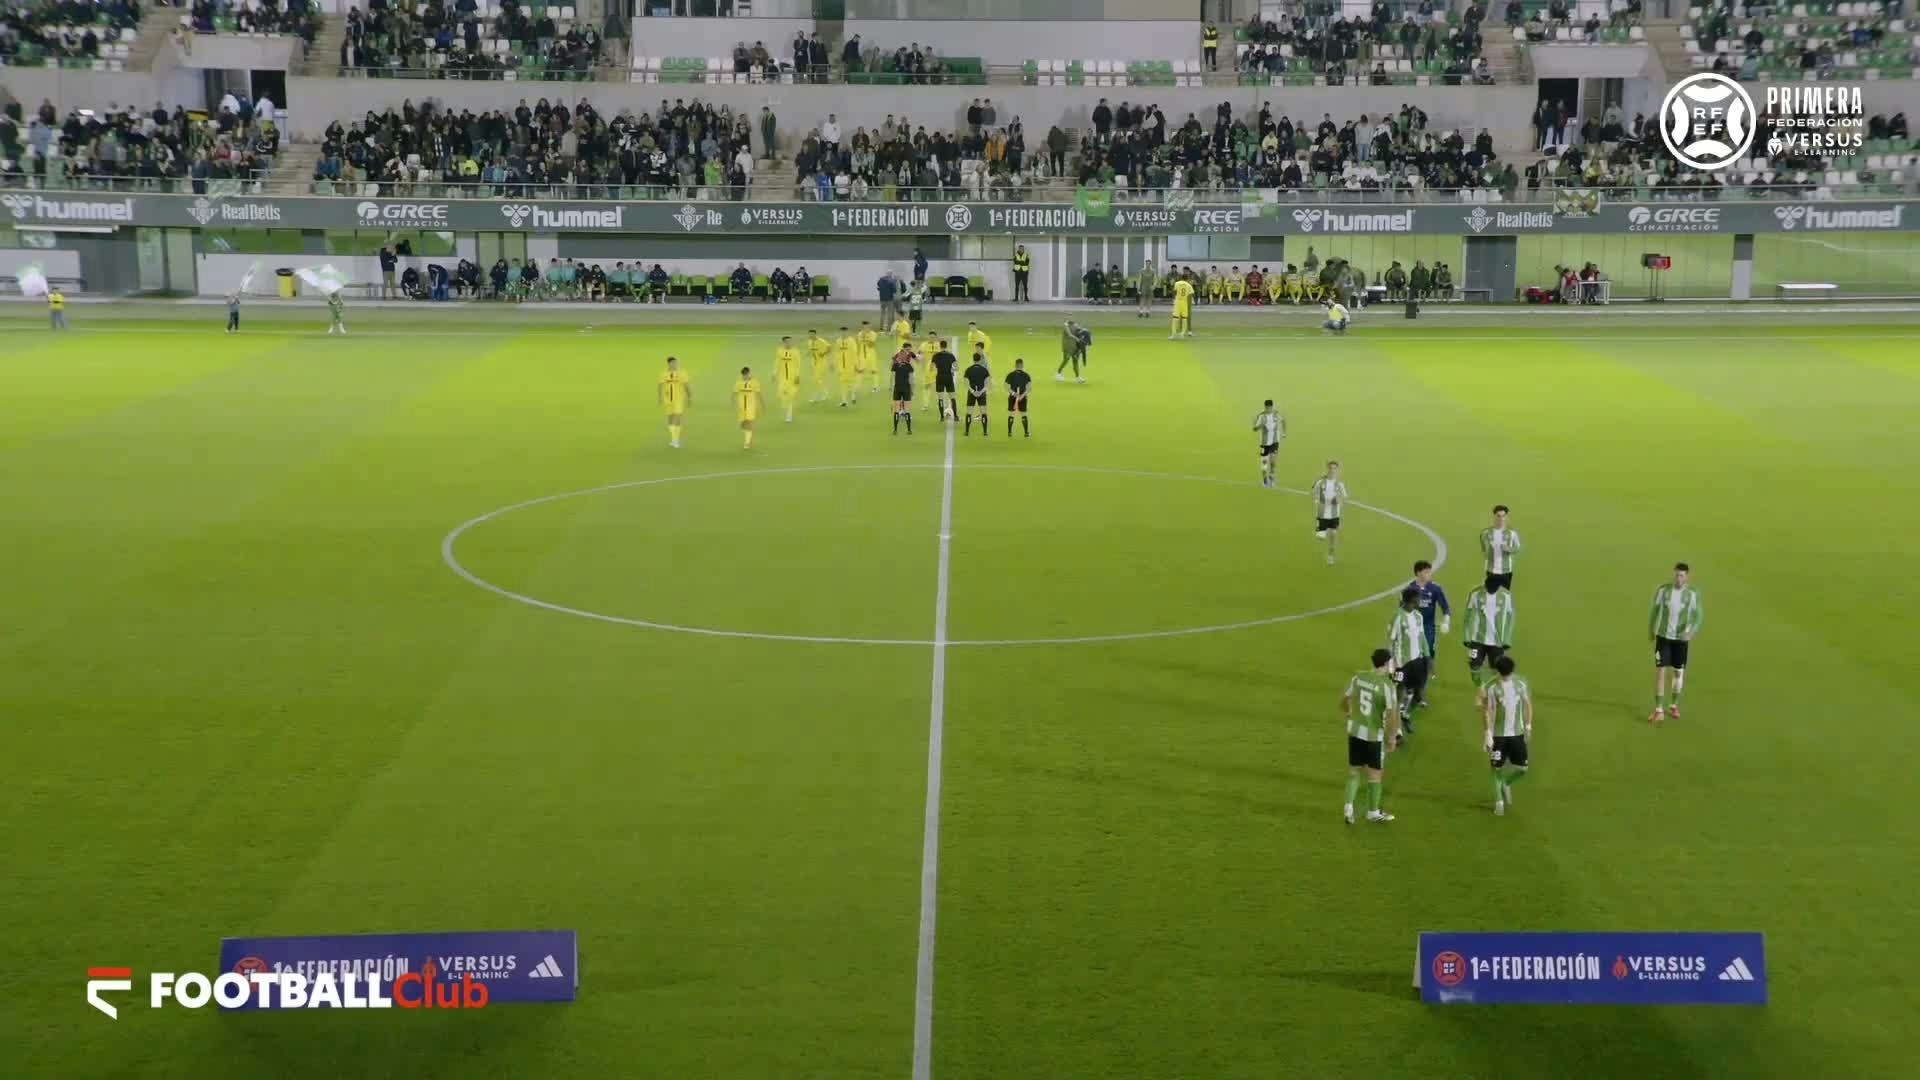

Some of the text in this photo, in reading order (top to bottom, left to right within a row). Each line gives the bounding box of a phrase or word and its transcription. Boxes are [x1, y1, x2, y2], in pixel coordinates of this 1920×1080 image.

[36, 199, 133, 220] hummel
[383, 204, 449, 219] GREE
[532, 206, 623, 227] hummel
[753, 209, 803, 220] VERSUS
[849, 206, 929, 226] FEDERACIÓN
[1126, 211, 1177, 222] VERSUS
[1193, 210, 1240, 224] REE
[1654, 208, 1721, 222] GREE
[1805, 205, 1902, 229] hummel
[359, 219, 449, 227] CLIMATIZACIÓN
[707, 210, 722, 225] Re
[1005, 208, 1086, 228] FEDERACIÓN
[1323, 209, 1412, 231] hummel
[1193, 224, 1240, 232] IZACIÓN
[1629, 223, 1719, 231] CLIMATIZACIÓN
[1360, 689, 1372, 716] 5
[439, 955, 517, 971] VERSUS
[1493, 953, 1600, 980] FEDERACIÓN
[1629, 956, 1706, 971] VERSUS
[447, 971, 510, 980] E-LARNING
[1638, 972, 1699, 980] E-LEARNING
